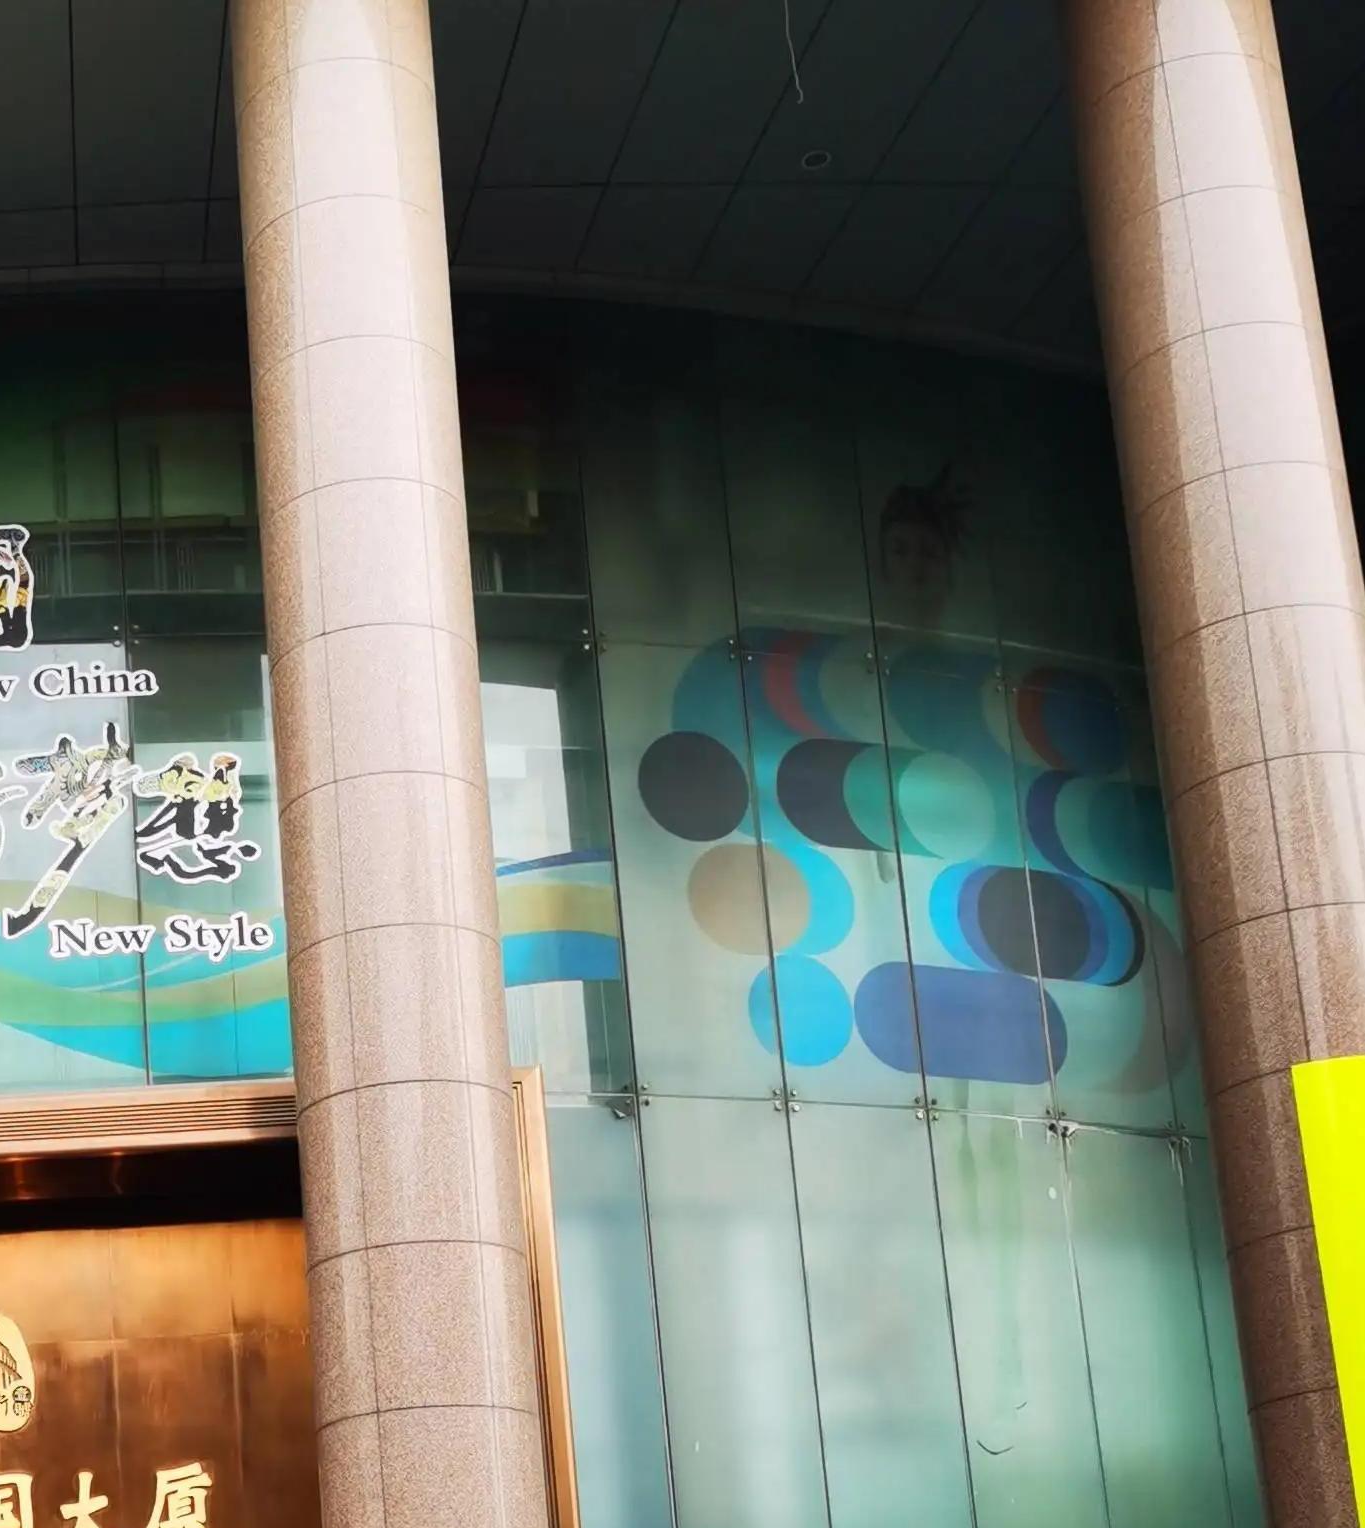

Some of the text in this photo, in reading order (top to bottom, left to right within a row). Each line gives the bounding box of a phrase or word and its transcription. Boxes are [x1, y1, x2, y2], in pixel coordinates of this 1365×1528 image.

[32, 663, 158, 696] China
[53, 914, 271, 960] New Style
